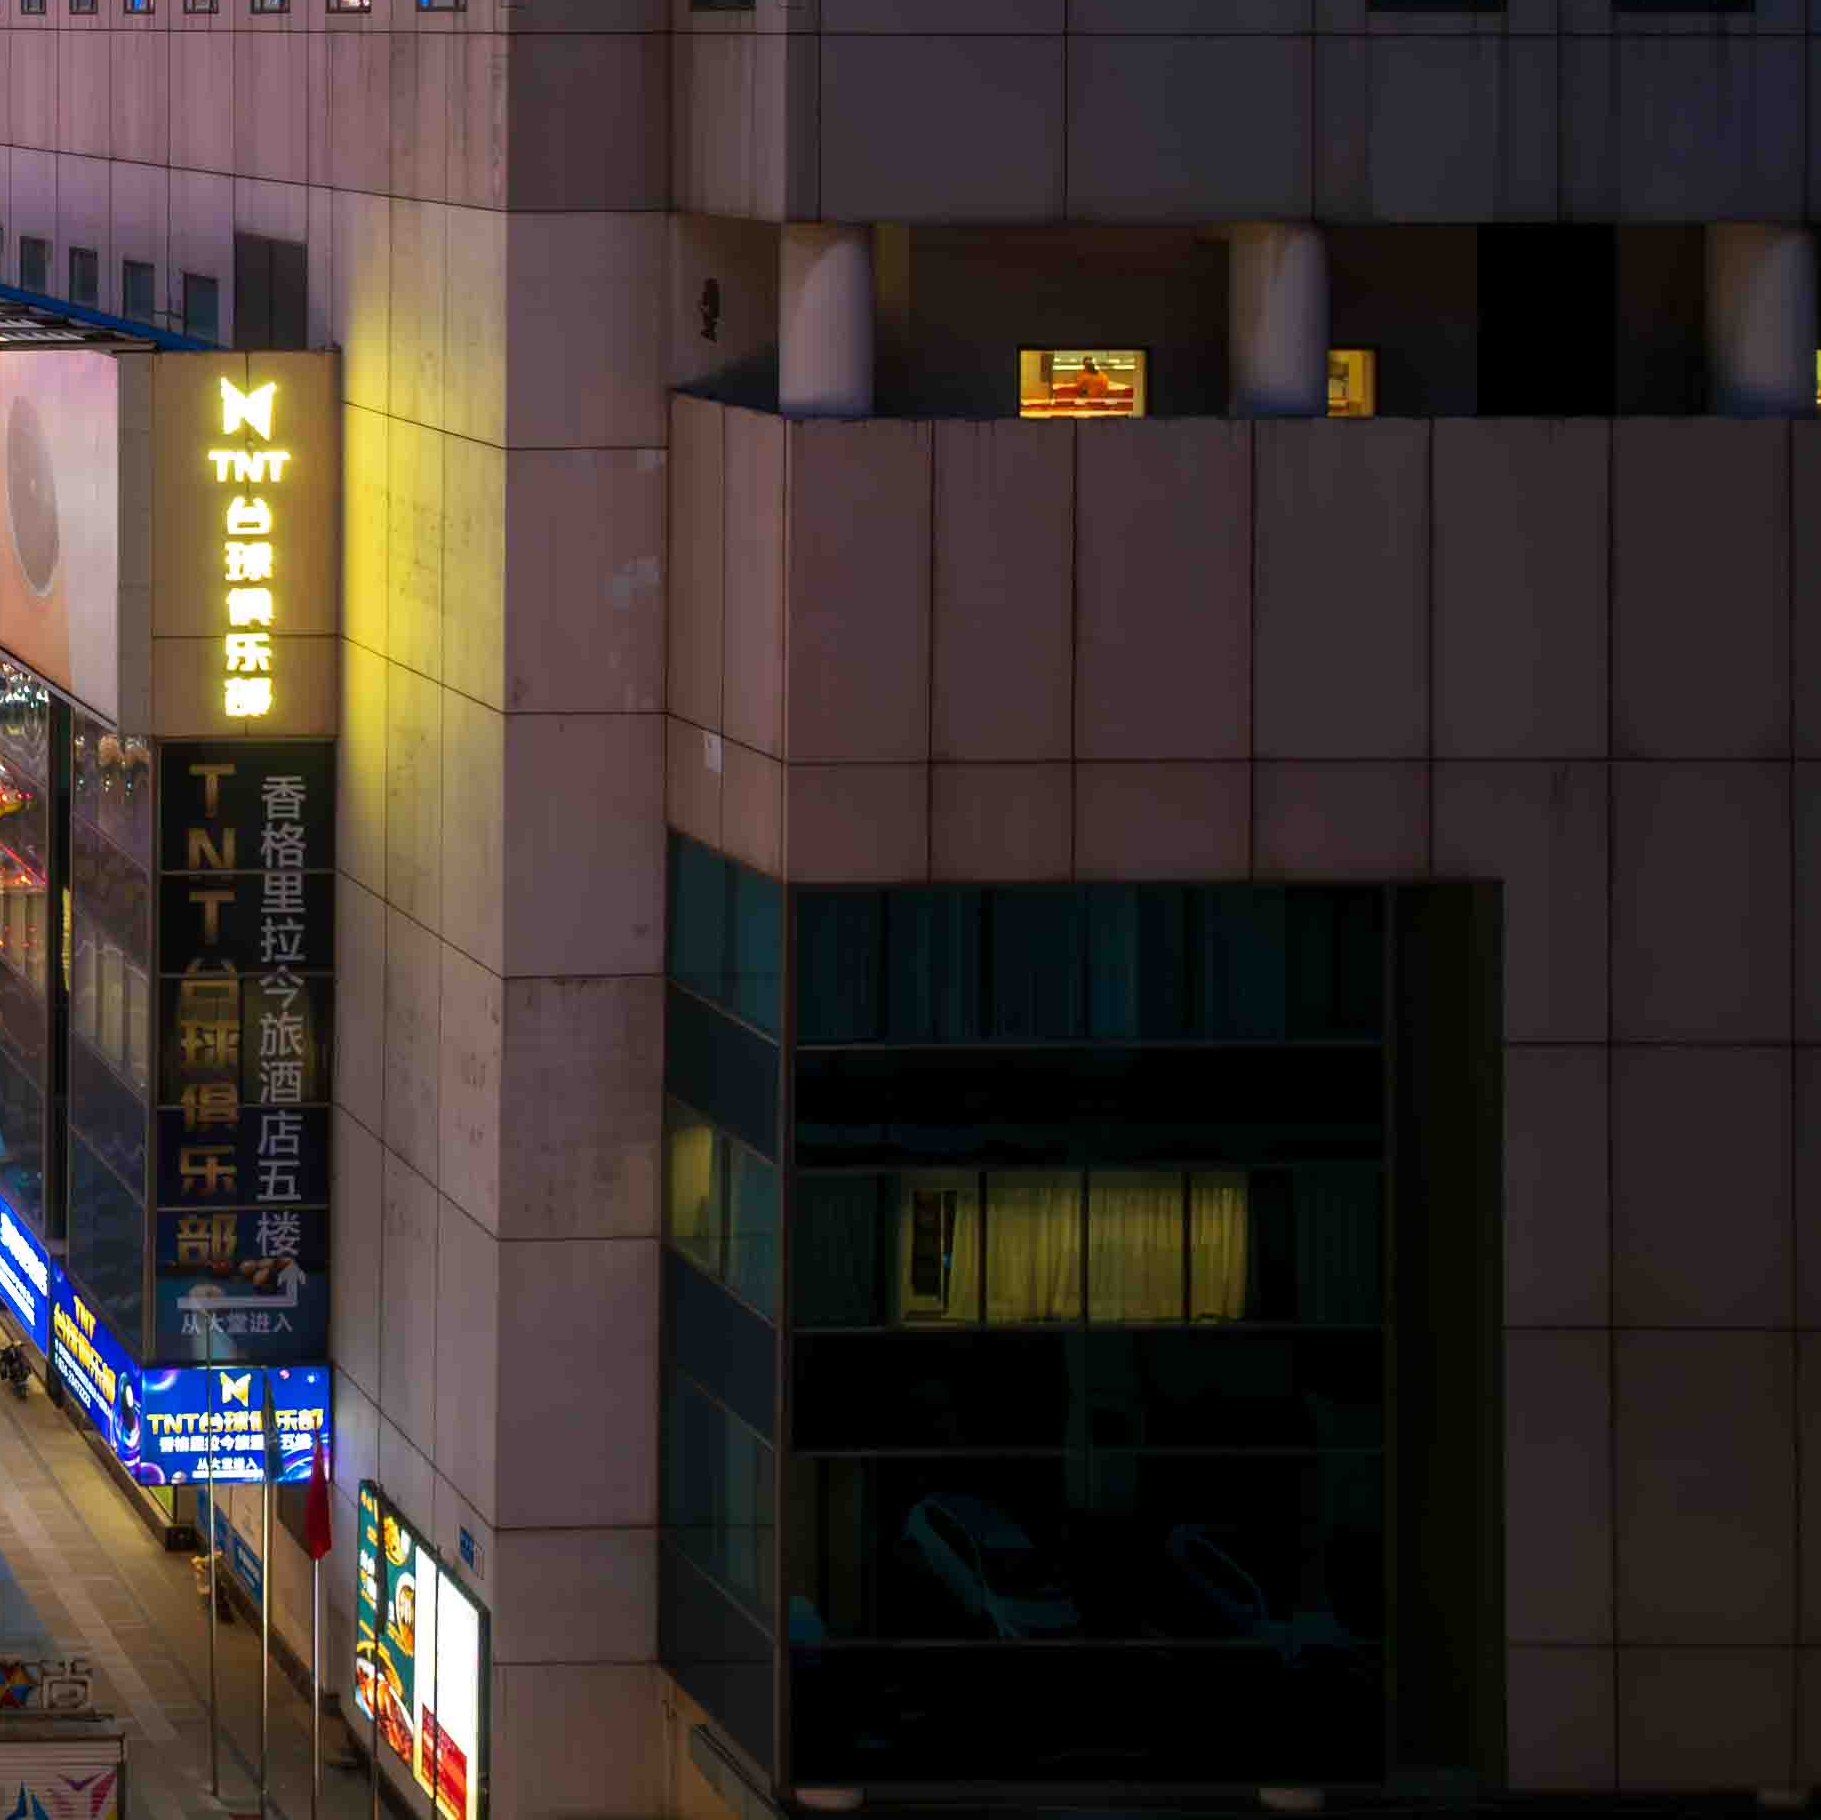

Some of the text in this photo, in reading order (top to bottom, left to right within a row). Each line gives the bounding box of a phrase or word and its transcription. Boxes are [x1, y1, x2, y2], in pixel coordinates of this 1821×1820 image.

[207, 450, 291, 484] TNT
[255, 774, 307, 1260] 香格里拉今旅酒店五楼
